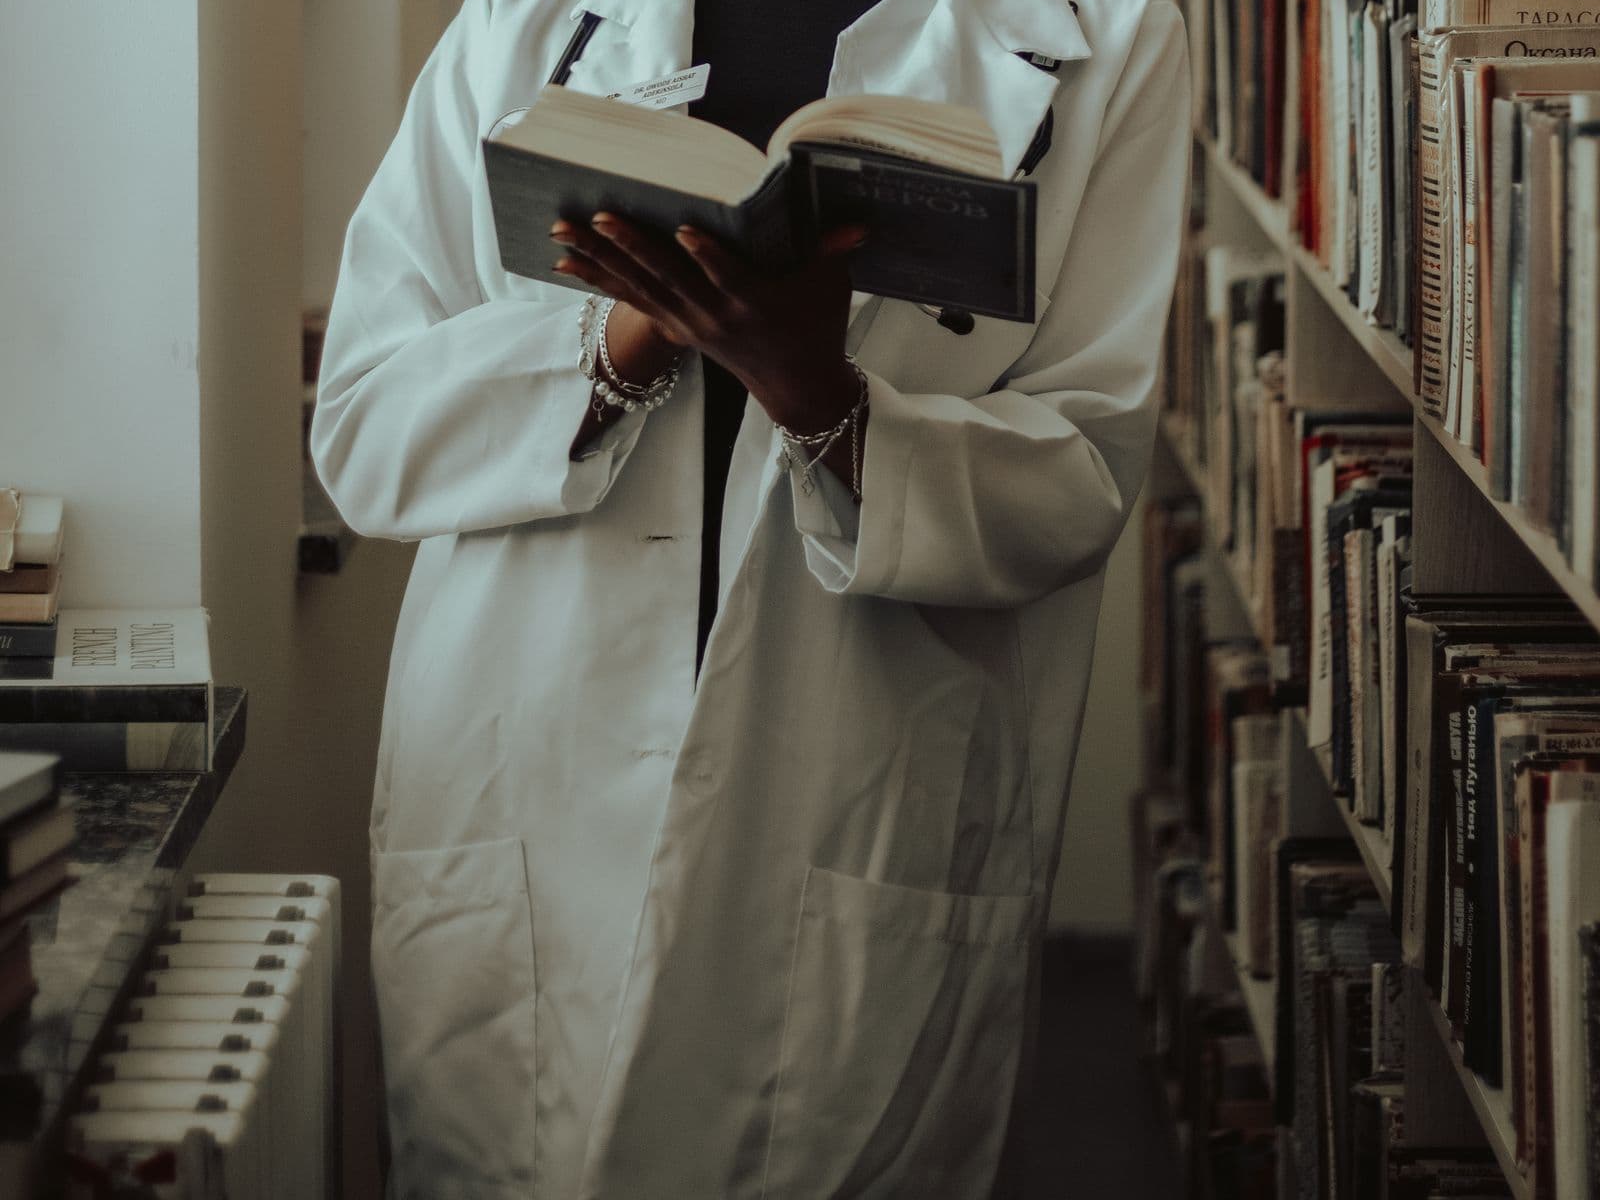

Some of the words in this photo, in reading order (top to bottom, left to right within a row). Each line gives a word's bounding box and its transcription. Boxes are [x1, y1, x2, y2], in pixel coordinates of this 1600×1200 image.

[72, 627, 118, 667] FRENCH
[130, 623, 175, 670] PAINTING
[1466, 704, 1478, 797] Луганью
[1467, 799, 1477, 840] Над
